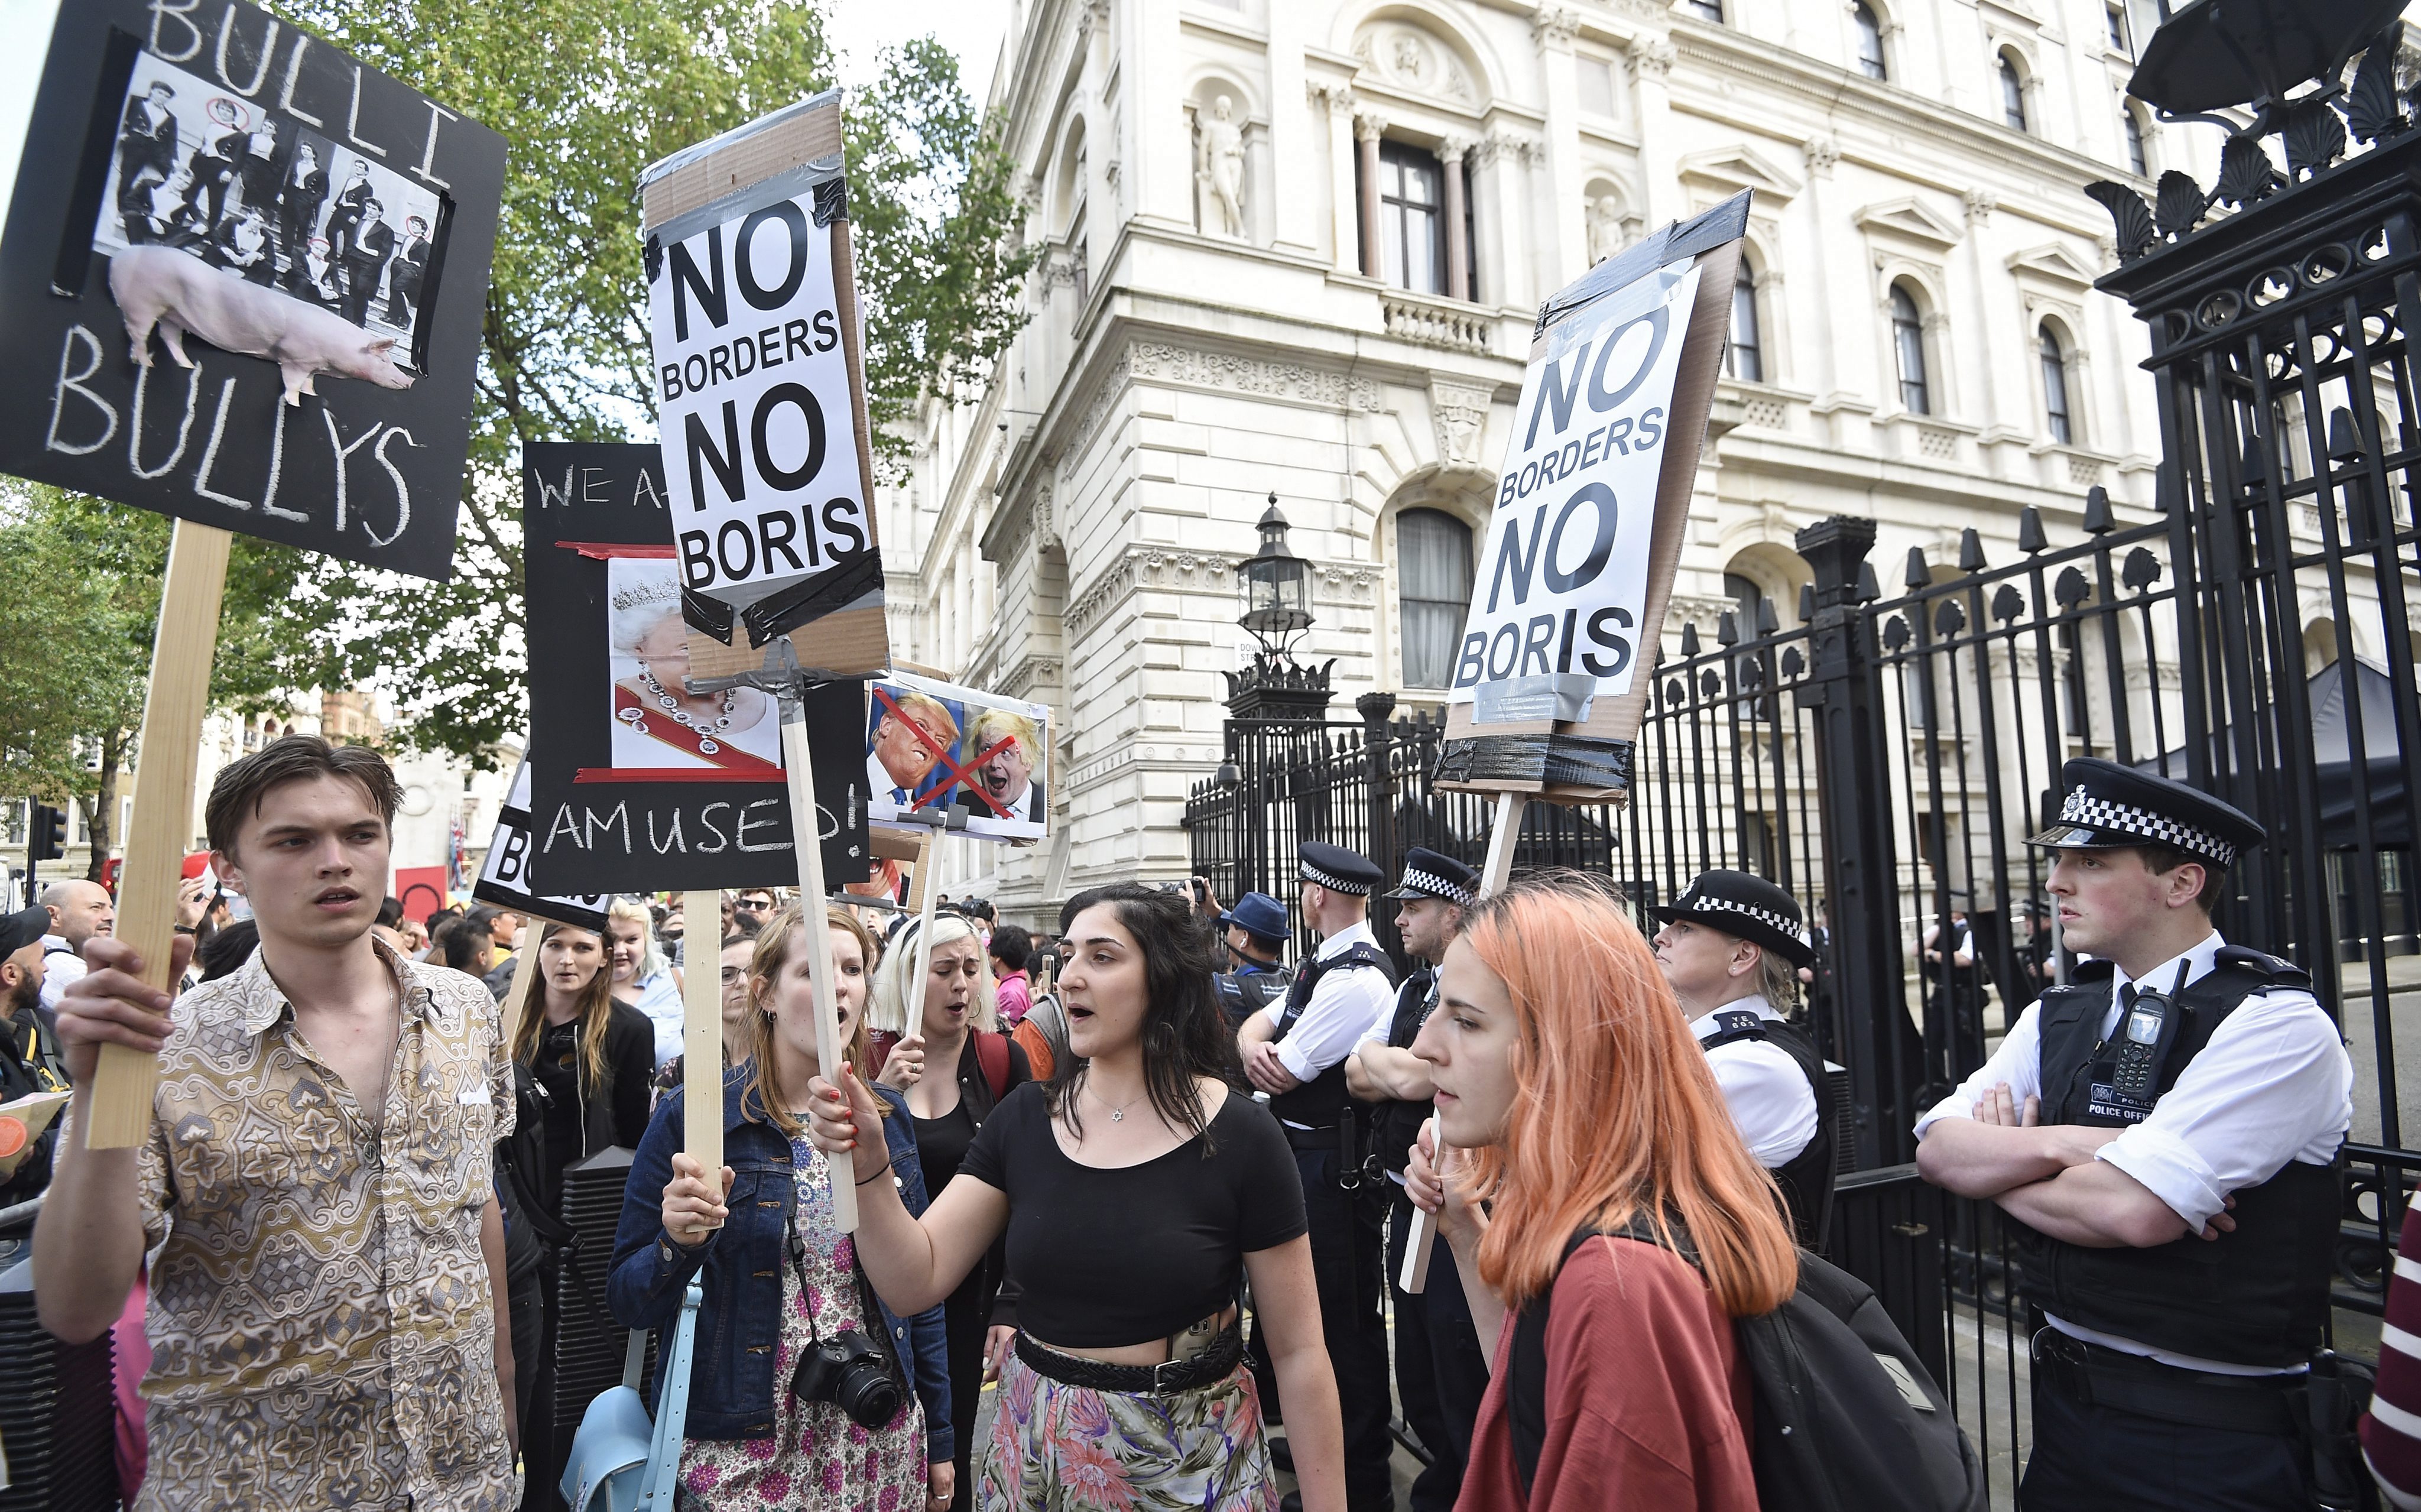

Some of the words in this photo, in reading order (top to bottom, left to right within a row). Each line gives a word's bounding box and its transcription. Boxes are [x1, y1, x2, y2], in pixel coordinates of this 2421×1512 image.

[149, 0, 459, 189] BULLI
[670, 199, 809, 343] NO
[663, 309, 838, 403] BORDERS
[1524, 304, 1669, 451] NO
[46, 325, 427, 547] BULLYS
[534, 463, 613, 510] WE
[685, 382, 827, 512] NO
[1500, 406, 1664, 508] BORDERS
[680, 497, 865, 589] BORIS
[1487, 482, 1618, 615] NO
[1455, 607, 1634, 689] BORIS
[2089, 1104, 2121, 1117] POLICE
[2122, 1098, 2154, 1108] POLICE
